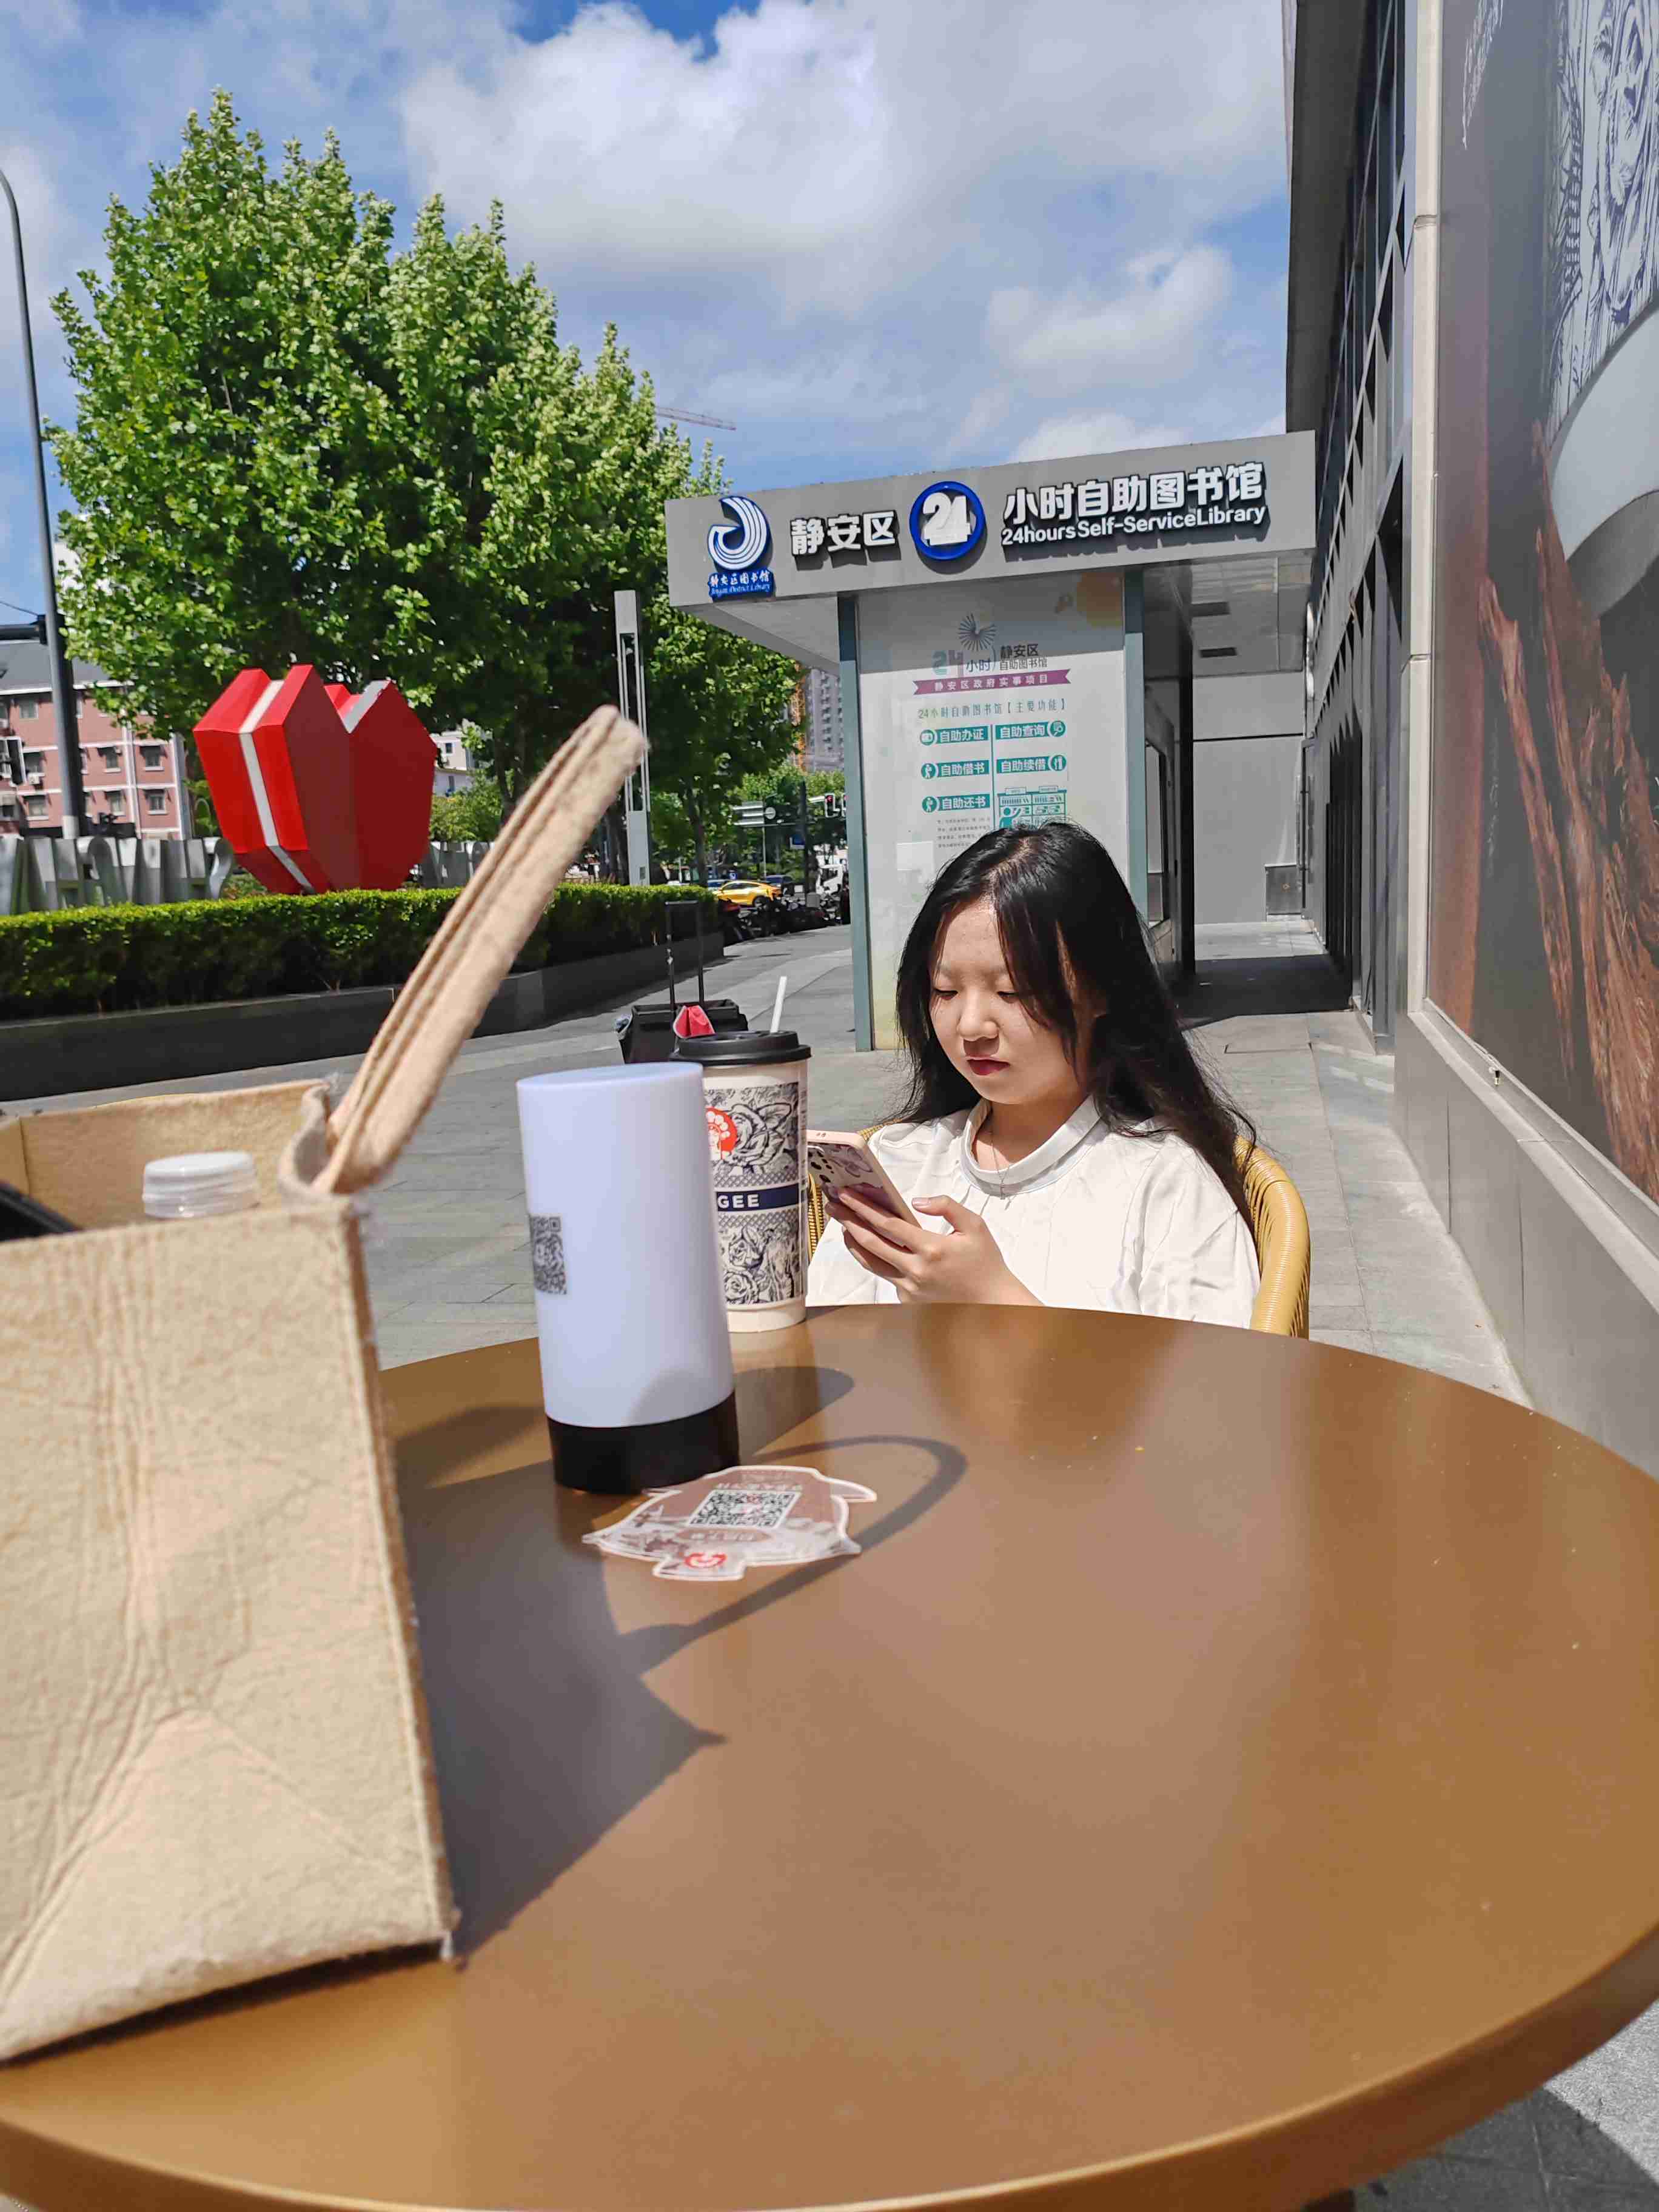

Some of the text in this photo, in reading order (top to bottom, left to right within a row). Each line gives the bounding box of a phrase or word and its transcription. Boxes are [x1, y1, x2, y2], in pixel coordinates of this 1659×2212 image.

[791, 461, 1263, 555] 静安区 24 小时自助图书馆
[1000, 643, 1039, 659] 静安区
[999, 658, 1048, 671] 自助图书馆
[934, 674, 1048, 691] 静安区政府实事项目
[940, 728, 984, 743] 自助办证
[1001, 723, 1045, 738] 自助查询
[941, 762, 985, 777] 自助借书
[1001, 758, 1047, 773] 自助续借
[942, 795, 987, 809] 自助还书
